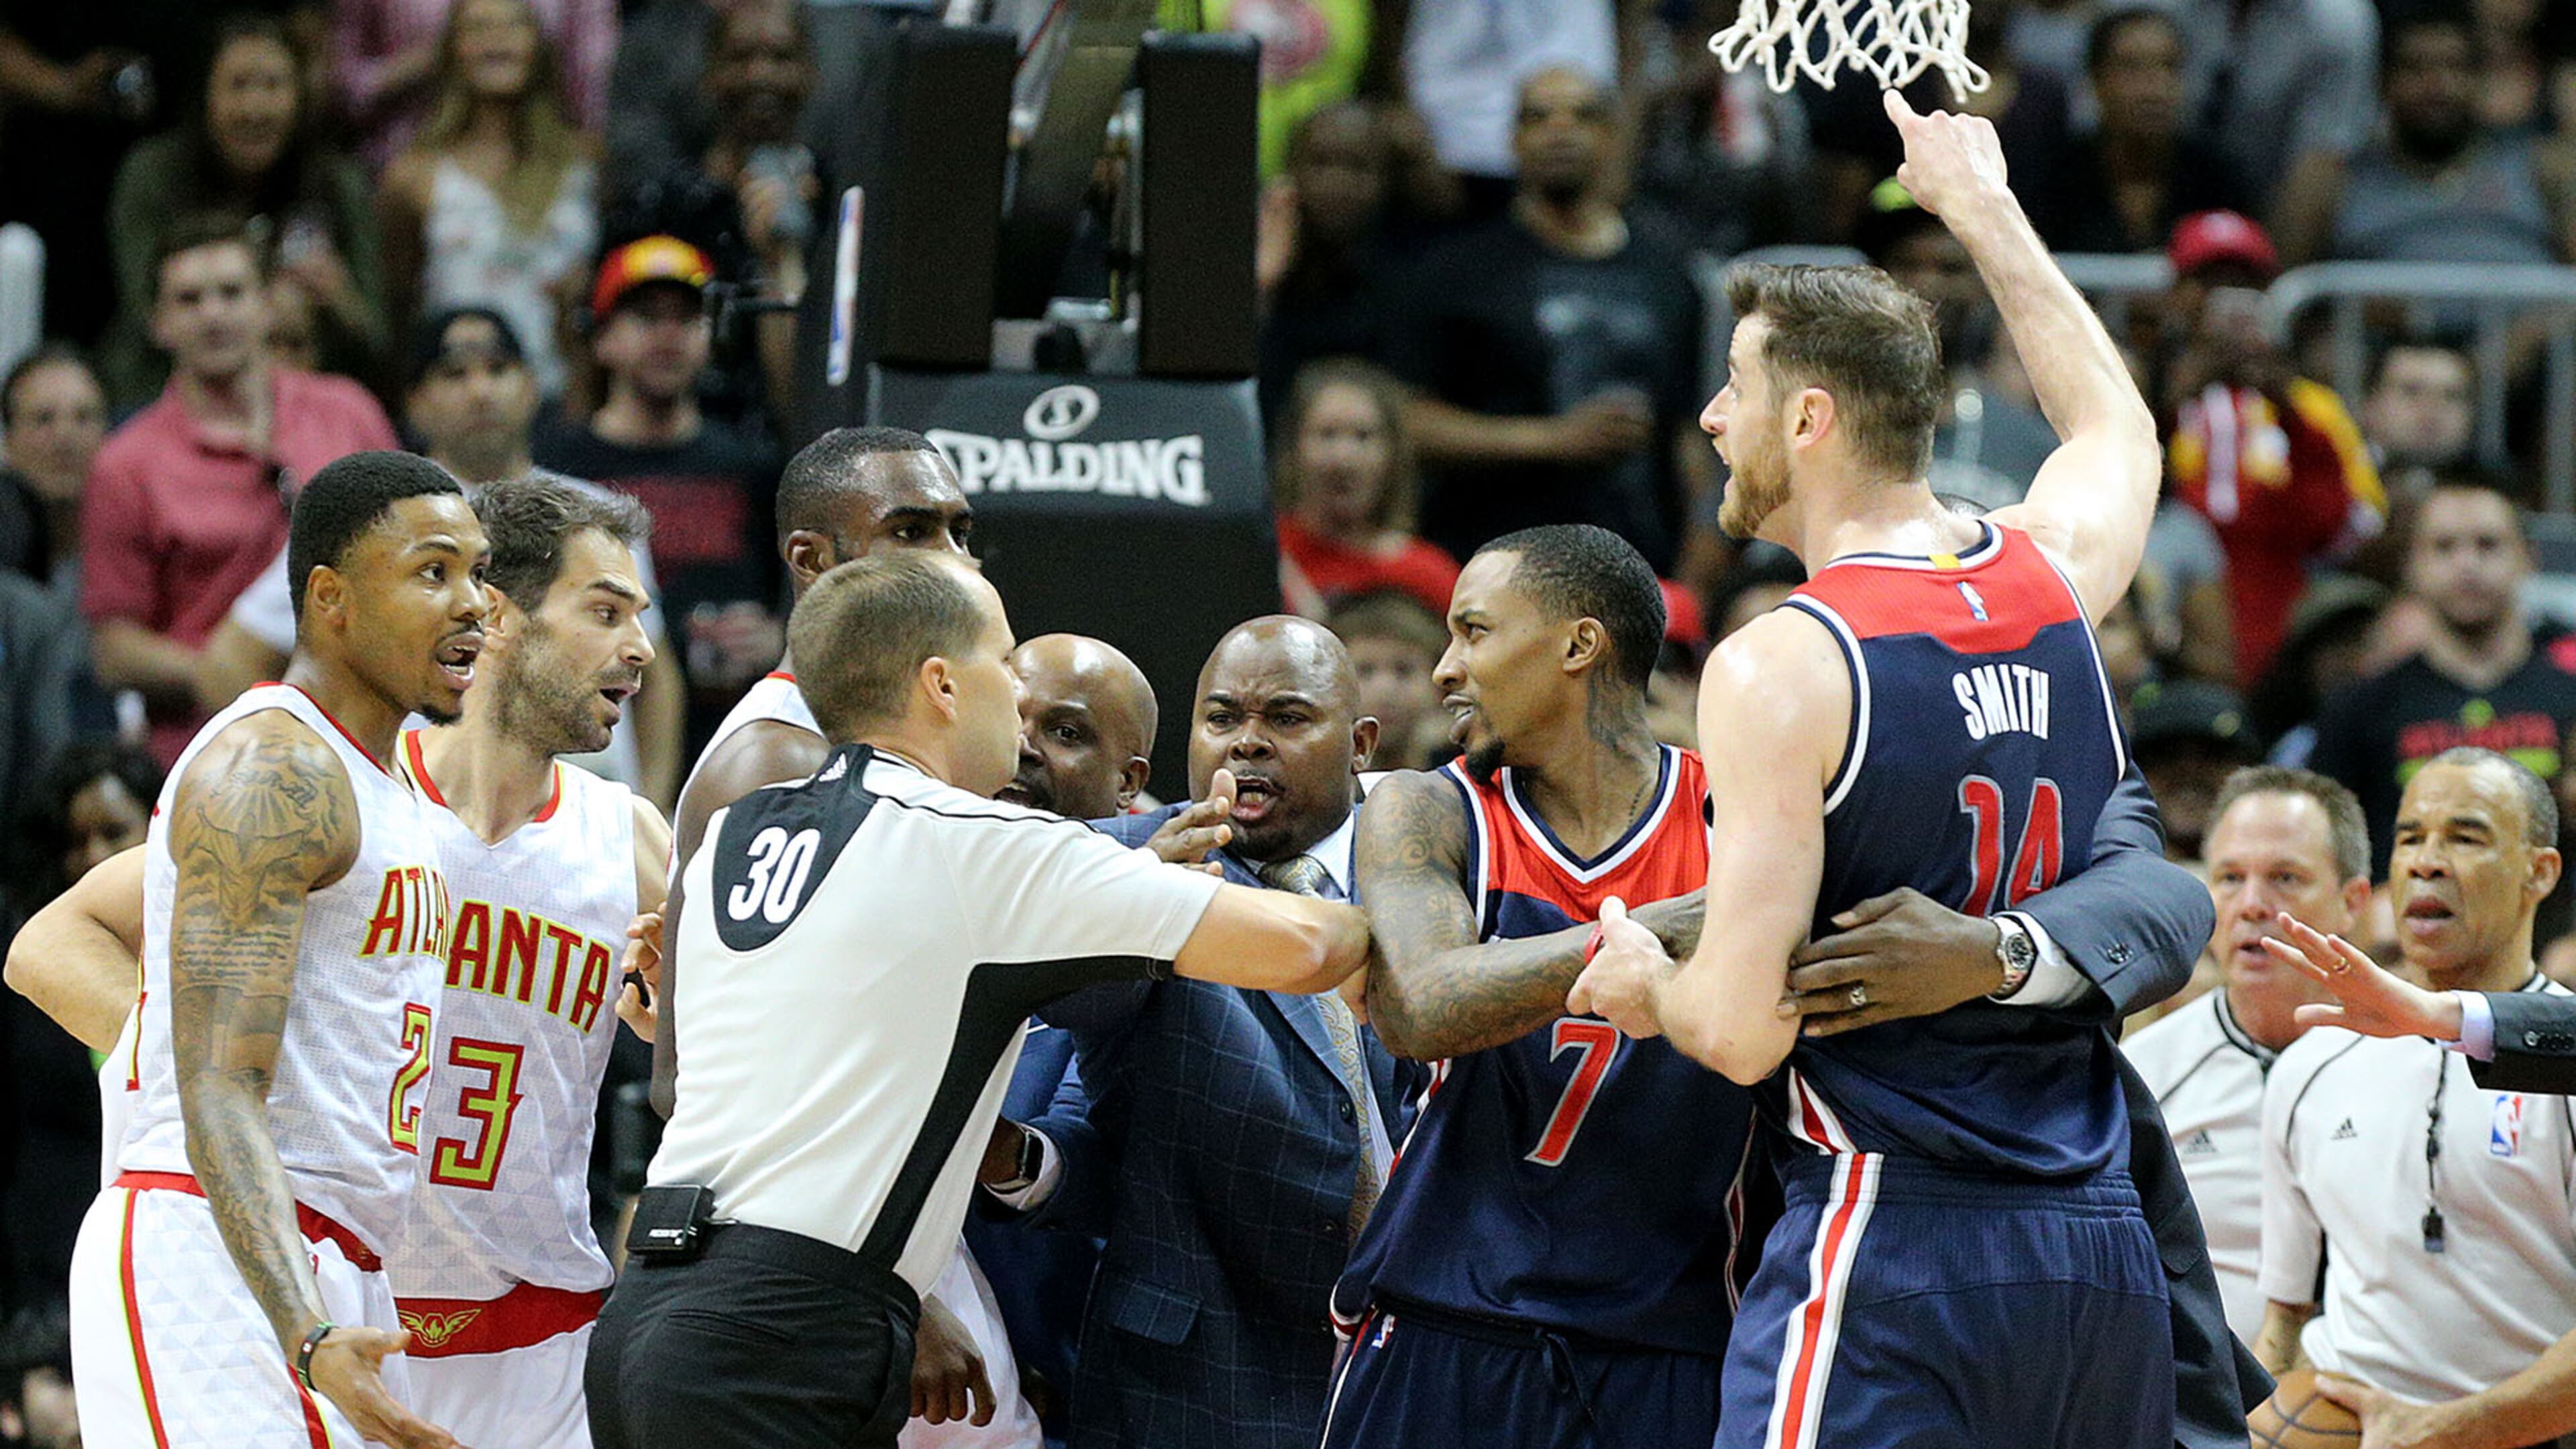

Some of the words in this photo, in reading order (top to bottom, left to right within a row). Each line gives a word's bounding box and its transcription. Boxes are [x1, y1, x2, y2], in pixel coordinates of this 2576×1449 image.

[1951, 663, 2049, 740] SMITH
[727, 826, 821, 924] 30
[1957, 774, 2063, 918] 14
[1523, 1017, 1621, 1167] 7
